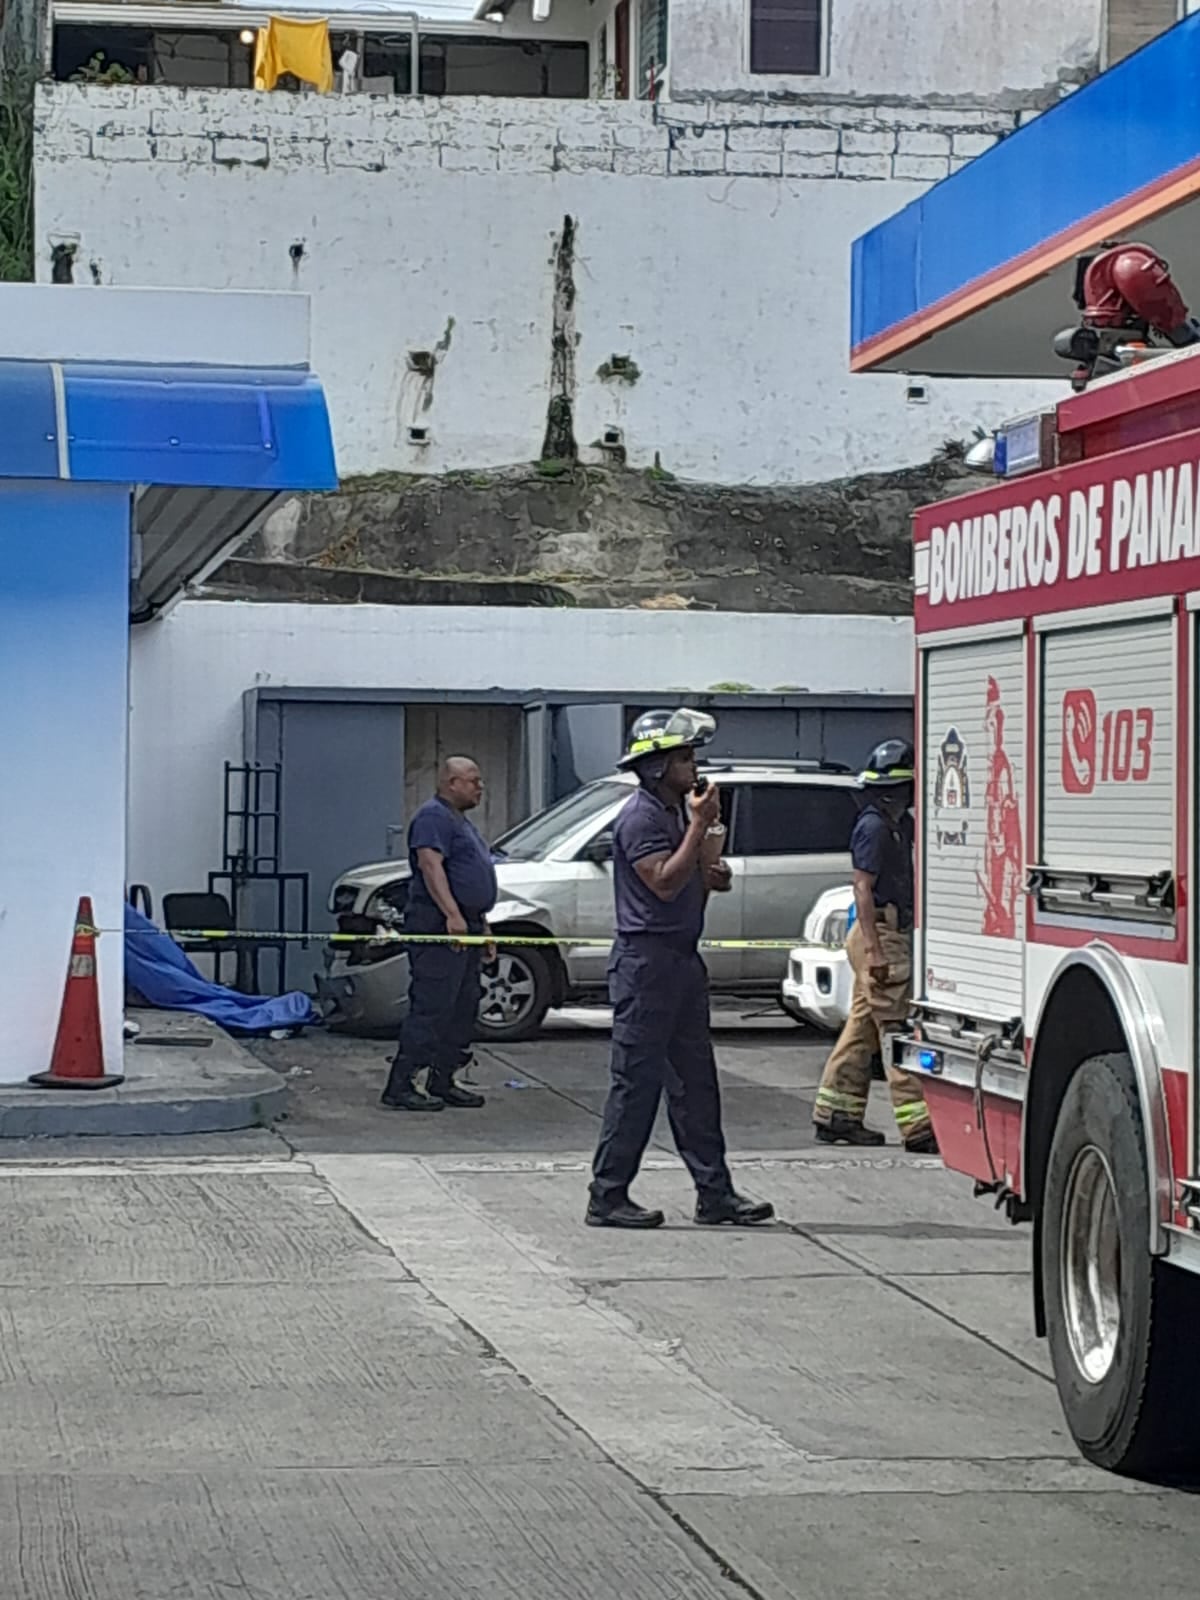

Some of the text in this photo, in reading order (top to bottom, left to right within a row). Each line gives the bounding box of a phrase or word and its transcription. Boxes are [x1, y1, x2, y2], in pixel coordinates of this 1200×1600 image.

[929, 460, 1200, 605] BOMBEROS DE PANA
[1101, 707, 1154, 781] 103
